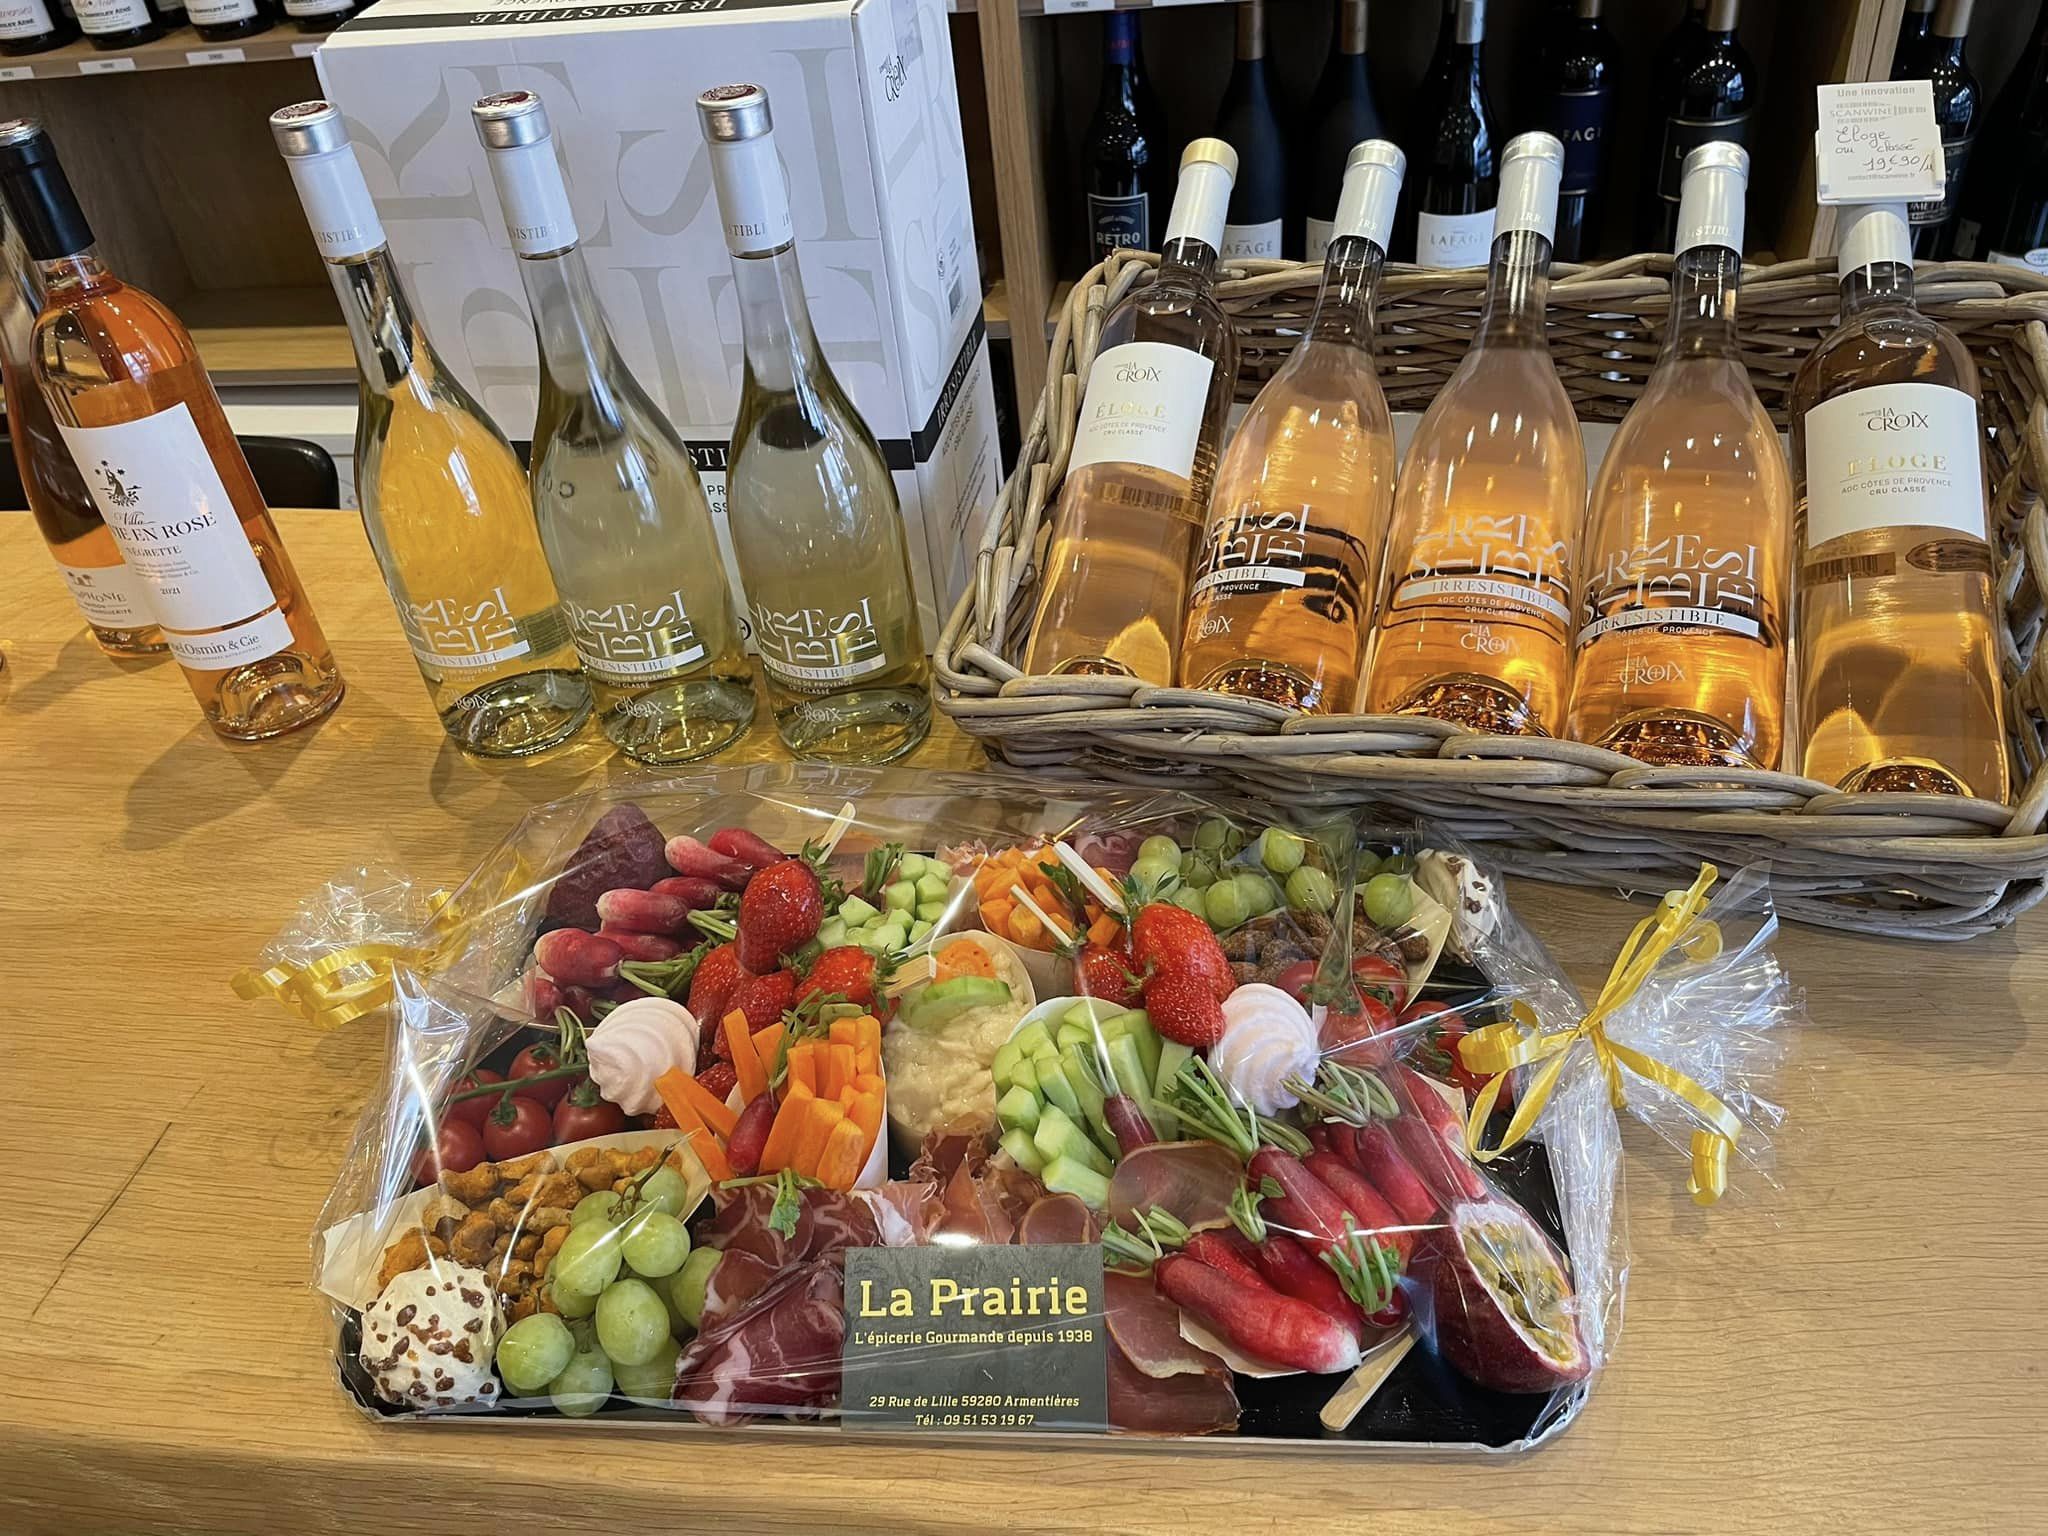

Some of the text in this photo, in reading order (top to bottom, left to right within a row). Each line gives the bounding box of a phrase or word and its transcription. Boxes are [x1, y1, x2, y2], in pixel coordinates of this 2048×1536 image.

[470, 0, 728, 24] IRRESISTIBLE
[1096, 231, 1141, 246] RETRO
[1225, 241, 1273, 254] AFAGE
[1115, 366, 1162, 383] CROIX
[1867, 411, 1929, 432] CROIX
[1841, 484, 1859, 495] AOC
[1860, 479, 1890, 489] CÔTES
[1907, 477, 1952, 487] PROVENCE
[1869, 486, 1927, 496] CRU CLASSÉ
[131, 526, 158, 542] EN
[161, 511, 217, 538] ROSE
[1220, 583, 1260, 592] PROVENCE
[1431, 580, 1554, 611] IRRESISTIBLE
[1437, 595, 1546, 620] AOC CÔTES DE PROVENCE
[1464, 605, 1484, 614] CRU
[1592, 609, 1726, 634] IRRESISTIBLE
[1662, 625, 1715, 637] PROVENCE
[184, 643, 227, 656] Osmin
[228, 640, 240, 650] &
[240, 634, 259, 647] Cie
[1619, 661, 1687, 685] CROIX
[859, 1277, 1089, 1317] La Prairie
[854, 1329, 1093, 1348] L'épicerie Gourmande depuis 1938
[869, 1393, 1080, 1408] 29 Rue de Lille 59280 Armentières
[943, 1414, 959, 1426] 09
[961, 1414, 978, 1426] 51
[980, 1414, 997, 1426] 53
[1000, 1414, 1015, 1426] 19
[1018, 1414, 1035, 1426] 67
